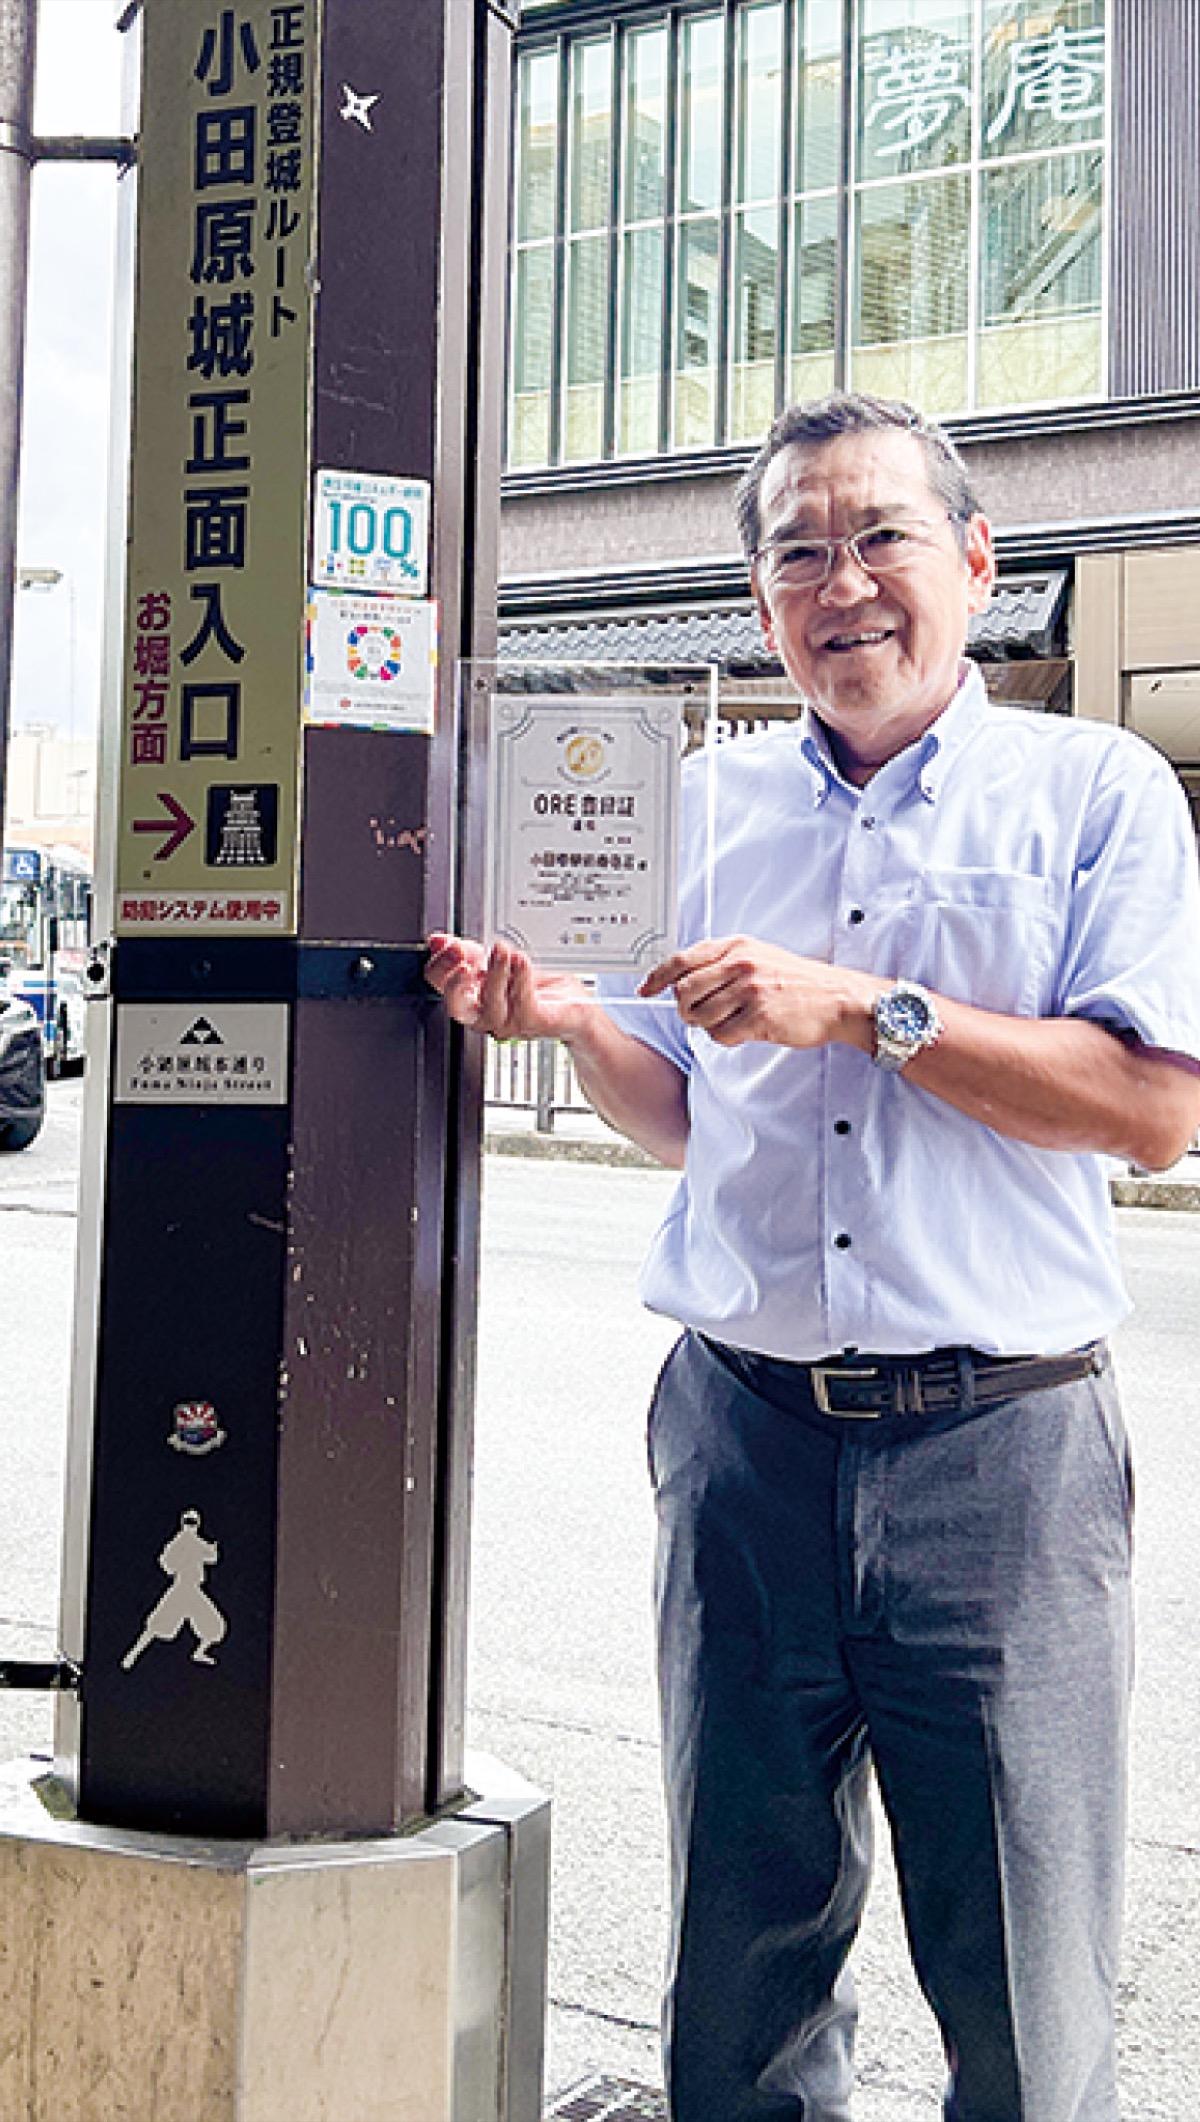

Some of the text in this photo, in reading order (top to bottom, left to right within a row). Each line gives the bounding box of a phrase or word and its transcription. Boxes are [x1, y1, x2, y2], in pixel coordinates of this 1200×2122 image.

[264, 5, 305, 338] 正規登城ルート
[863, 25, 1105, 157] 夢庵
[179, 9, 261, 761] 小田原城正面入口
[130, 592, 172, 766] お堀方面
